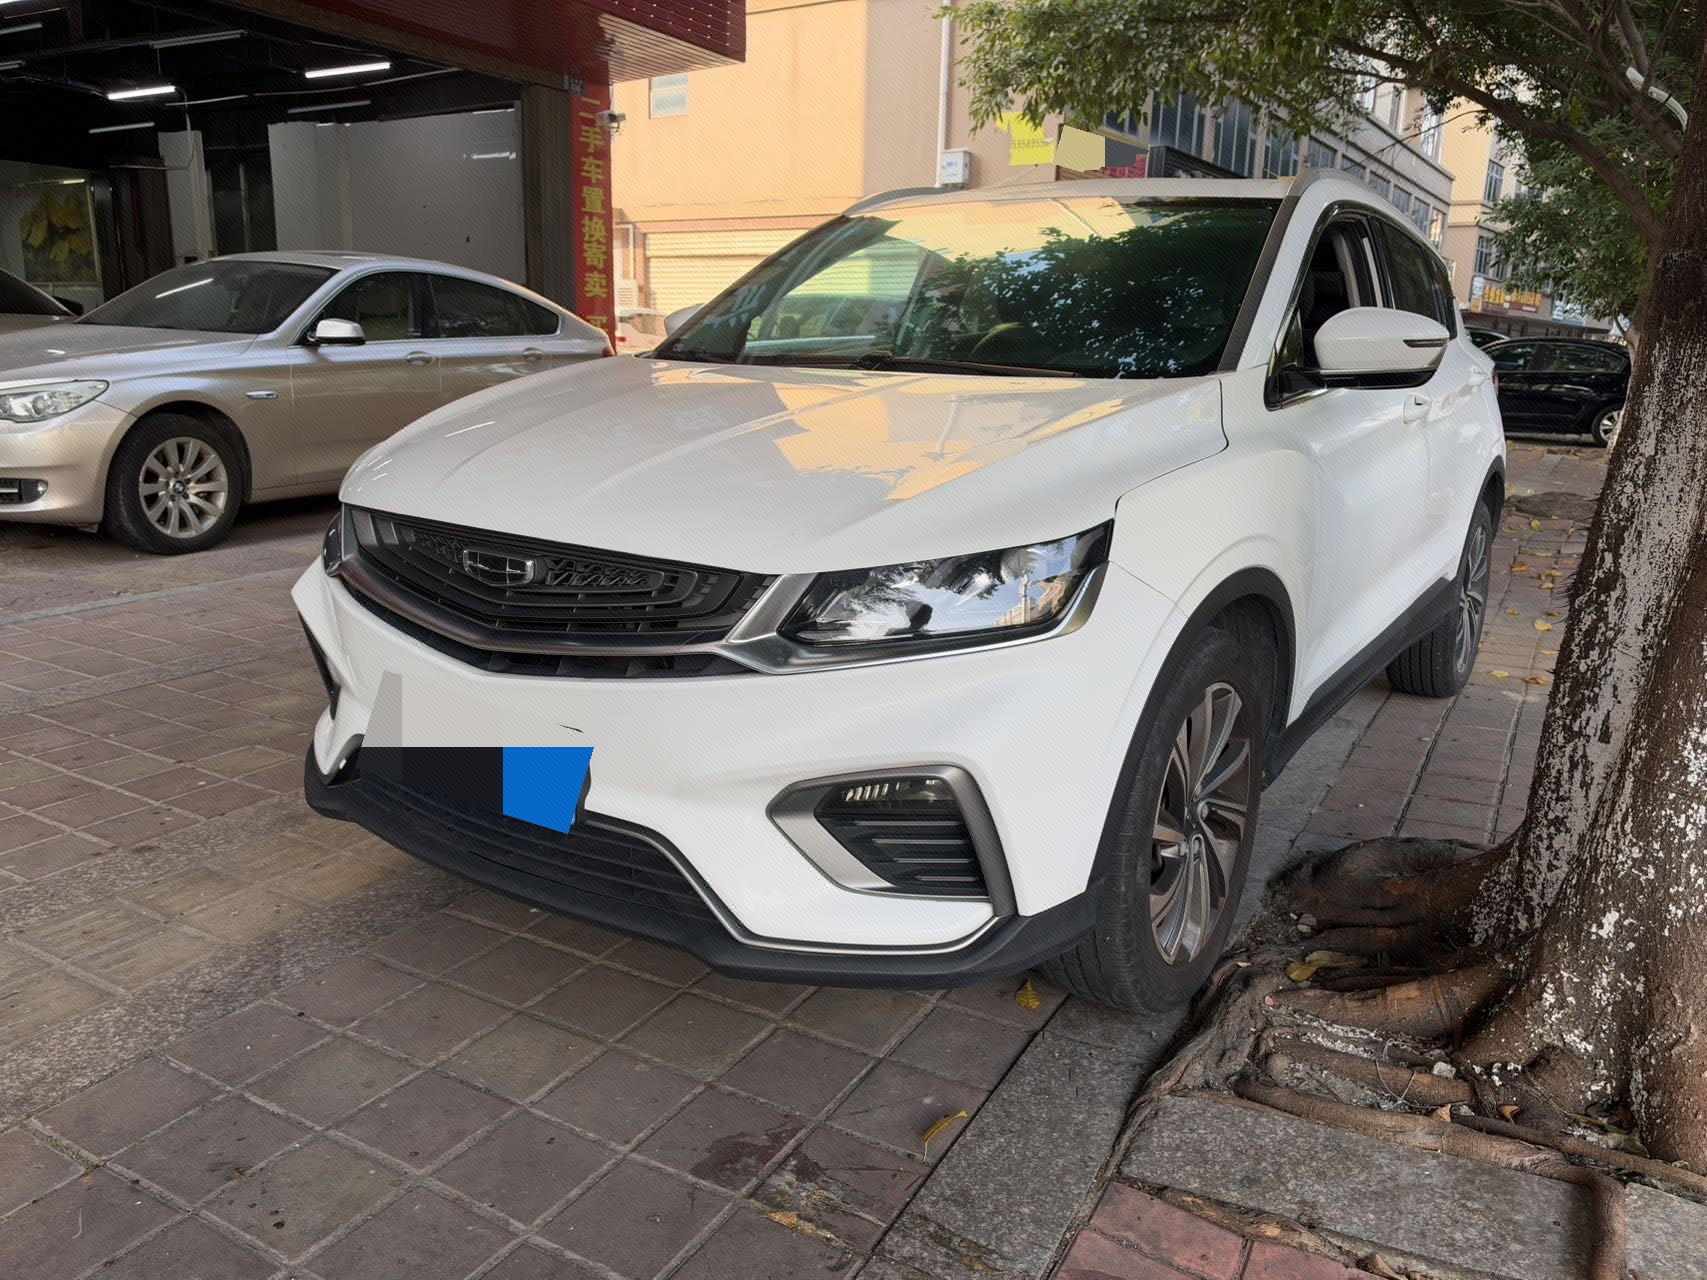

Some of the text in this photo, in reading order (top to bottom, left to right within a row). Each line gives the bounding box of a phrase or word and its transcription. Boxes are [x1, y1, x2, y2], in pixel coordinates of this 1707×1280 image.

[578, 96, 608, 298] 二手车置换寄卖
